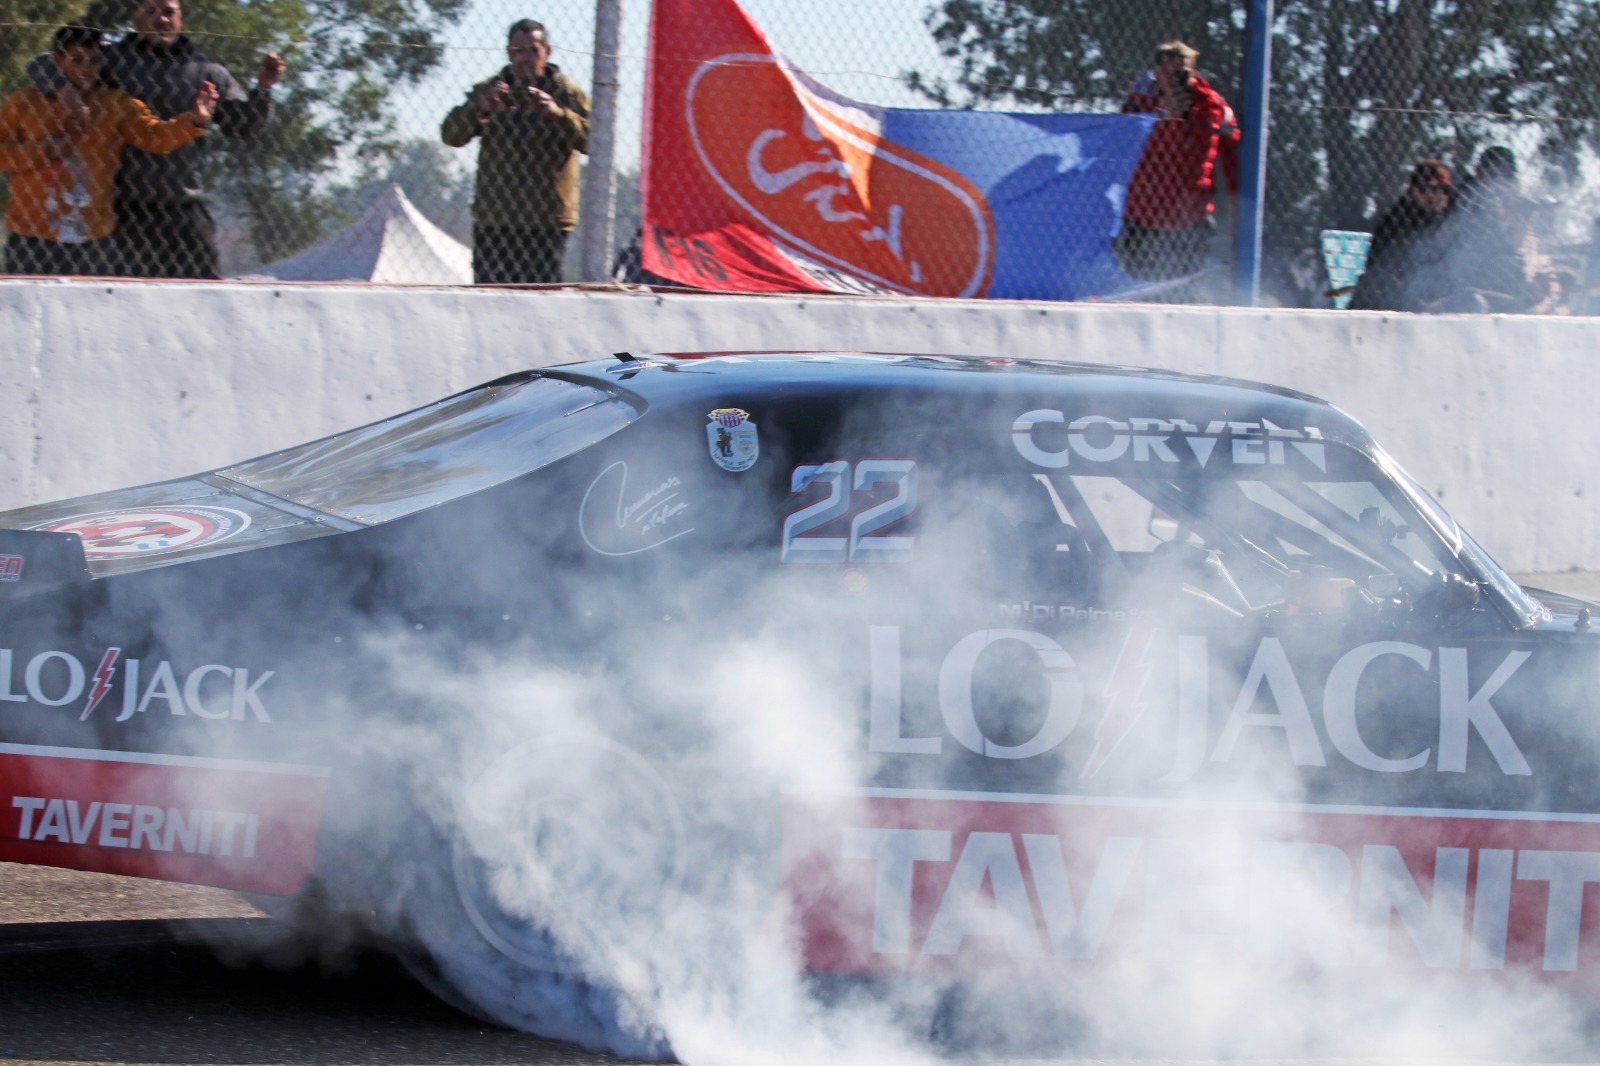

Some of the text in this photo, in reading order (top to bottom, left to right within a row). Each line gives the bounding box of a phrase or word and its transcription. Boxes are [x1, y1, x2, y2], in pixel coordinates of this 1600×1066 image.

[1012, 408, 1327, 474] CORVEN
[781, 457, 918, 565] 22
[1031, 604, 1056, 619] Di
[1059, 606, 1127, 621] Palma
[0, 648, 276, 723] LO JACK
[868, 624, 1534, 784] LO JACK
[12, 796, 259, 858] TAVERNITI
